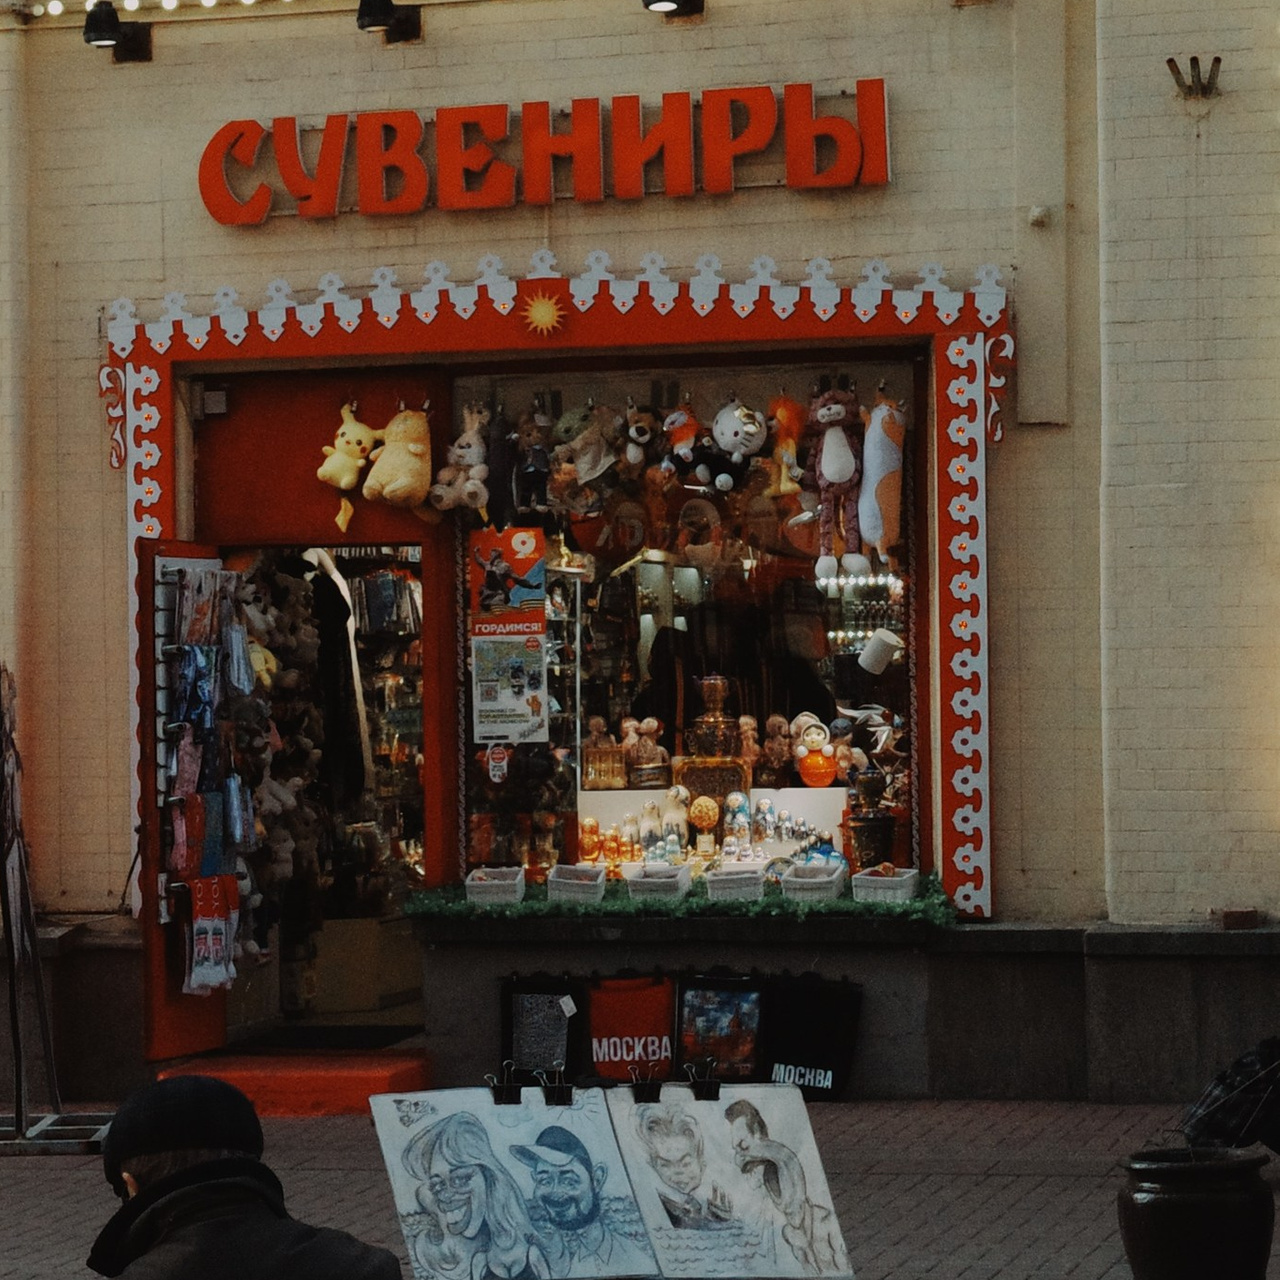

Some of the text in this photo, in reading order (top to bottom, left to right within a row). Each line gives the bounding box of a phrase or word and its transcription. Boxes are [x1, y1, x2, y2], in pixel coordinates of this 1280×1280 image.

[198, 77, 890, 227] СУВЕНИРЫ
[475, 622, 542, 634] ГОРДИМСЯ!
[591, 1035, 671, 1063] МОСКВА
[771, 1062, 833, 1090] МОСКВА
